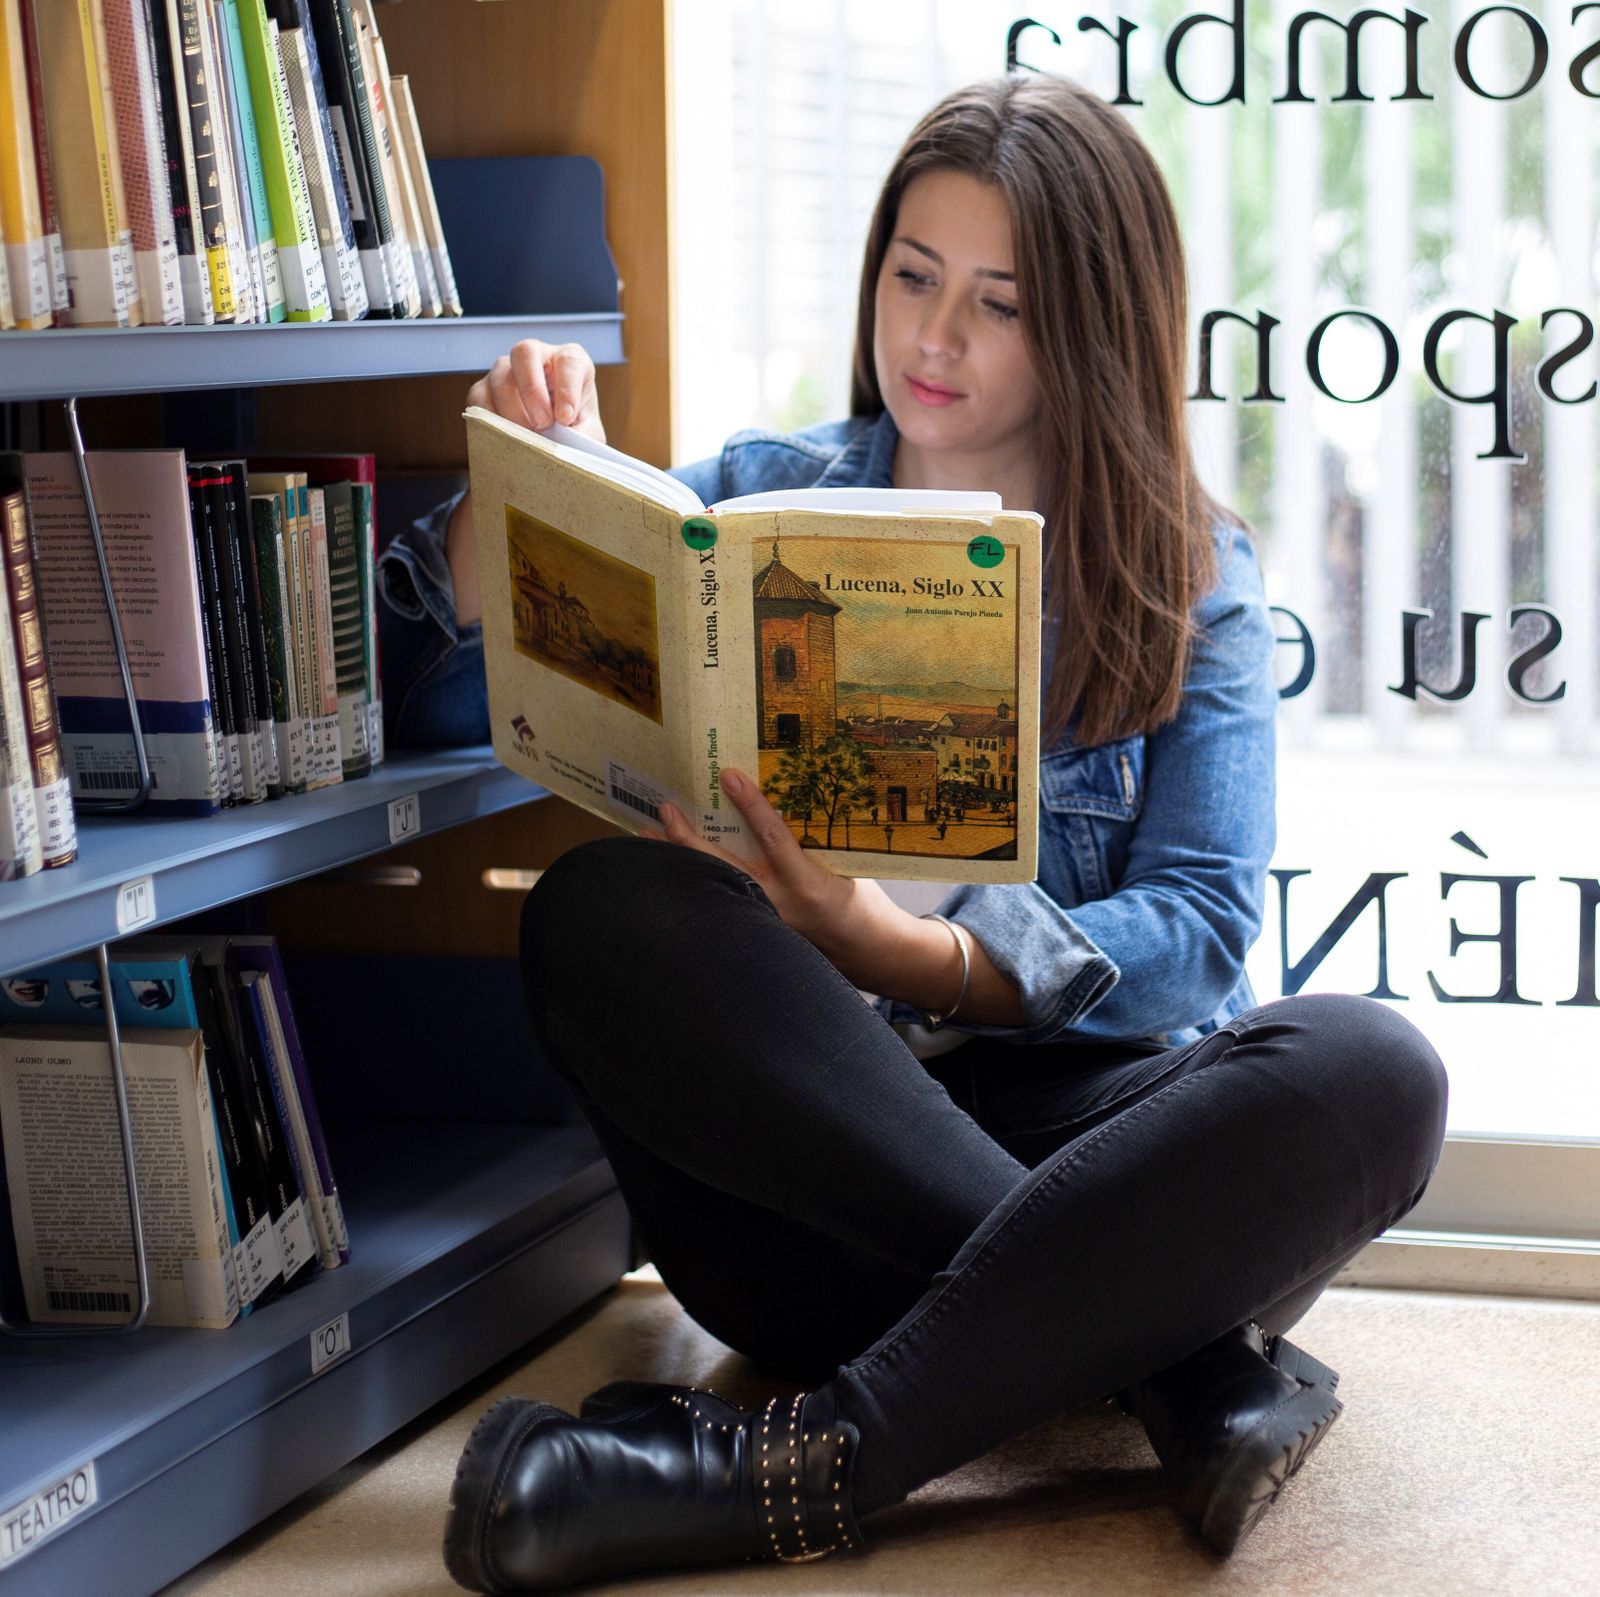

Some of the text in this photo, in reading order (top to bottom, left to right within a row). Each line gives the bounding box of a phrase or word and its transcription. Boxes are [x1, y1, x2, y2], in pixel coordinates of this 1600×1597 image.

[700, 569, 721, 606] Siglo
[825, 573, 1005, 600] Lucena, Siglo XX
[905, 607, 1003, 618] Juan Antonio Parejo Pineda
[704, 610, 720, 669] Lucena,
[707, 728, 717, 759] Pineda
[708, 761, 720, 790] Parejo
[265, 1124, 273, 1151] Teatro
[233, 1138, 242, 1165] Teatro
[247, 1196, 256, 1225] Olmo
[279, 1184, 288, 1210] Olmo
[281, 1210, 299, 1234] 821.134.2
[247, 1225, 266, 1250] 821.134.2
[252, 1257, 262, 1272] OLM
[4, 1472, 87, 1552] TEATRO
